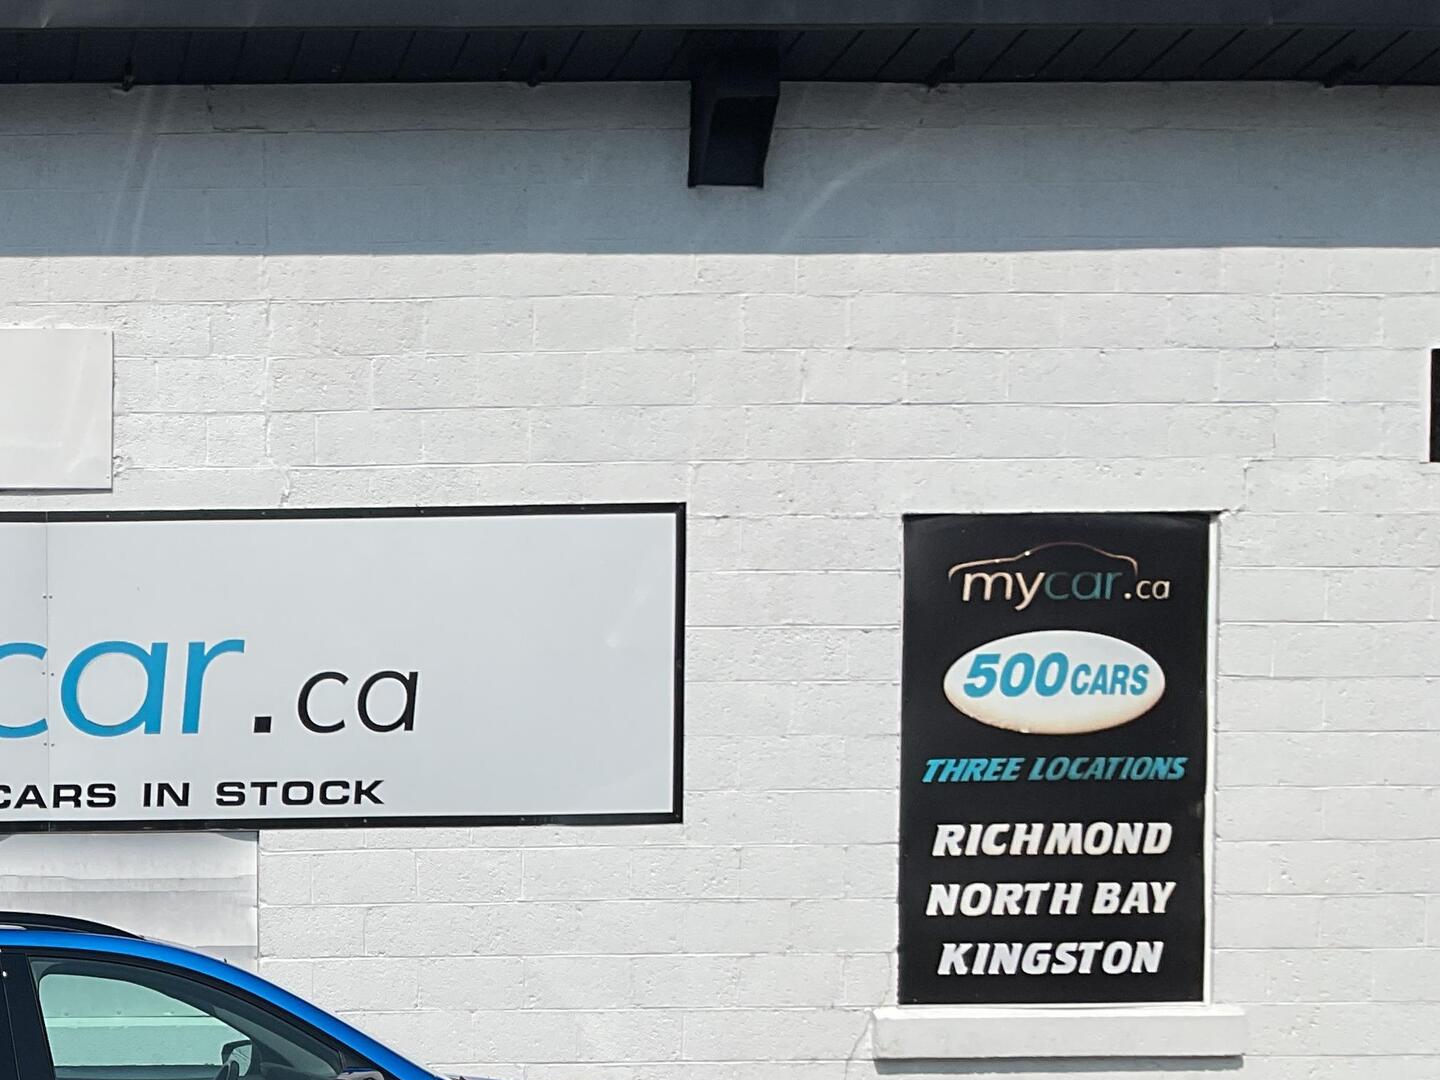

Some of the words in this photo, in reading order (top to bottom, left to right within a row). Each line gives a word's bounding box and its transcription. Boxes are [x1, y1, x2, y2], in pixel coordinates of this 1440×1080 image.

[962, 569, 1171, 610] mycar.ca
[964, 652, 1069, 698] 500
[1070, 663, 1149, 696] CARS
[921, 757, 1024, 783] THREE
[1027, 756, 1189, 781] LOCATIONS
[142, 781, 191, 808] IN
[214, 779, 386, 807] STOCK
[931, 822, 1172, 858] RICHMOND
[924, 882, 1084, 917] NORTH
[1091, 881, 1177, 915] BAY
[936, 941, 1165, 977] KINGSTON
